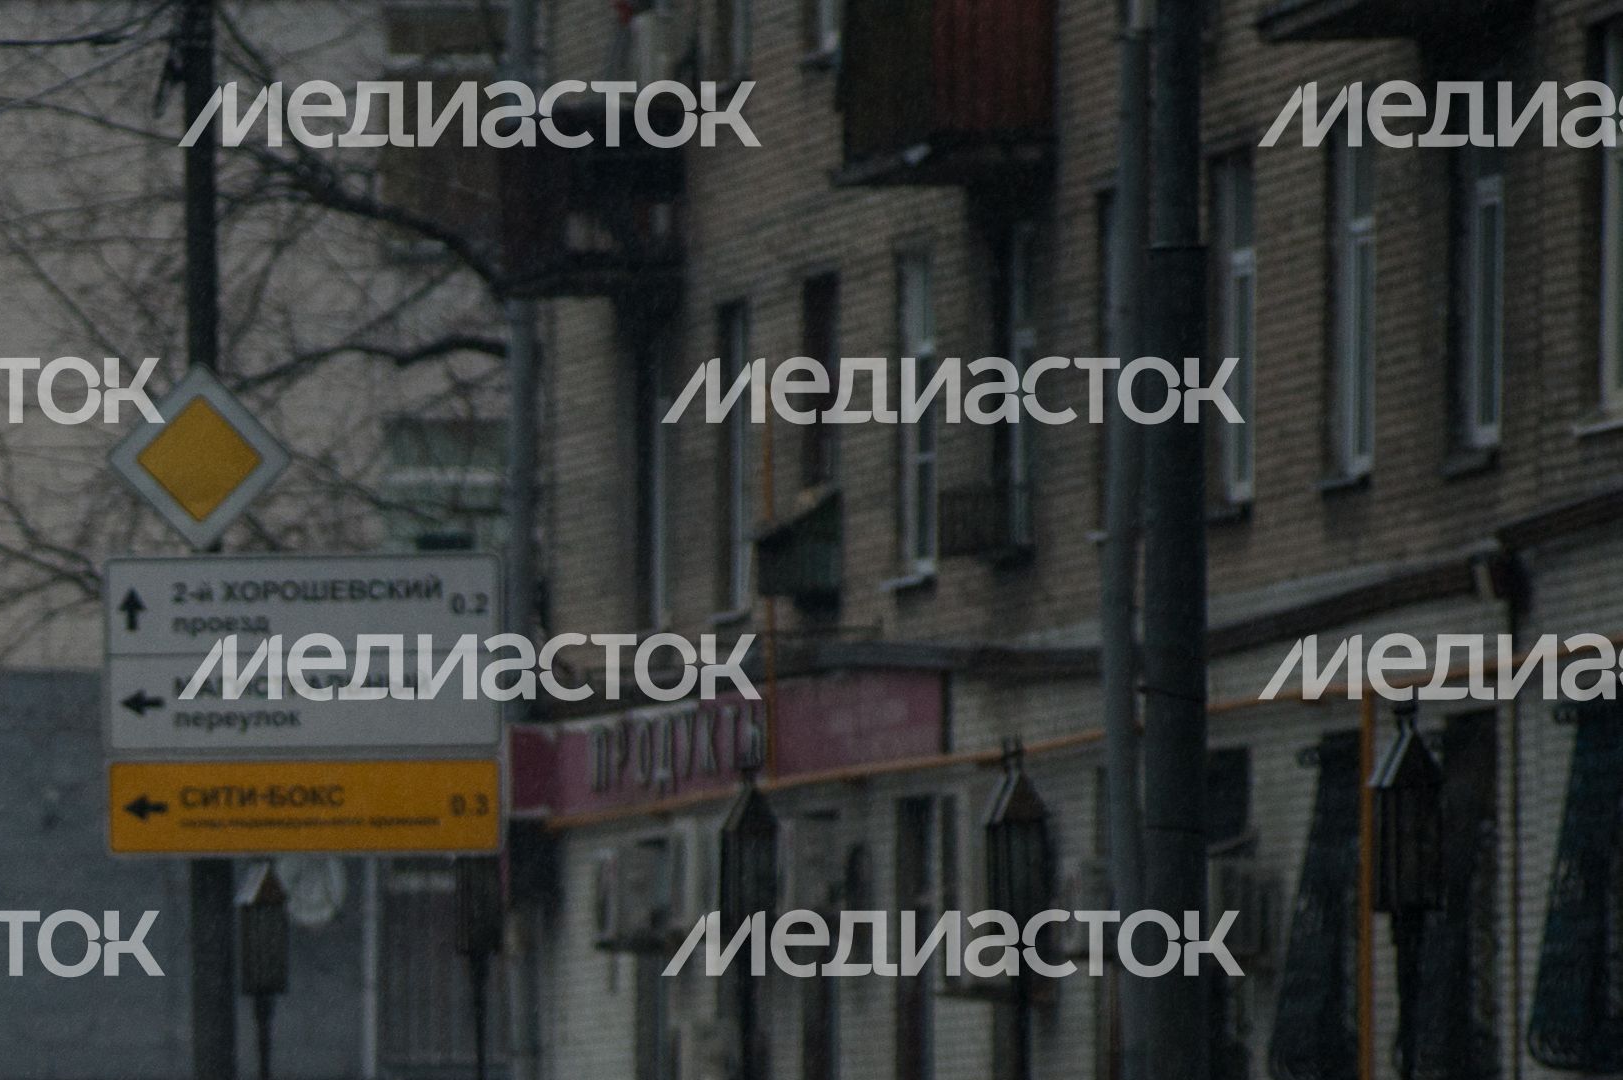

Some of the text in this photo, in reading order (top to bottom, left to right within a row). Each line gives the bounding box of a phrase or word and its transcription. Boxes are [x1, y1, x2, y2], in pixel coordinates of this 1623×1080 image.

[222, 575, 443, 602] ХОРОШЕВСКИЙ
[172, 615, 271, 637] проезд
[173, 709, 301, 733] переулок
[180, 784, 345, 810] СИТИ-БОКС
